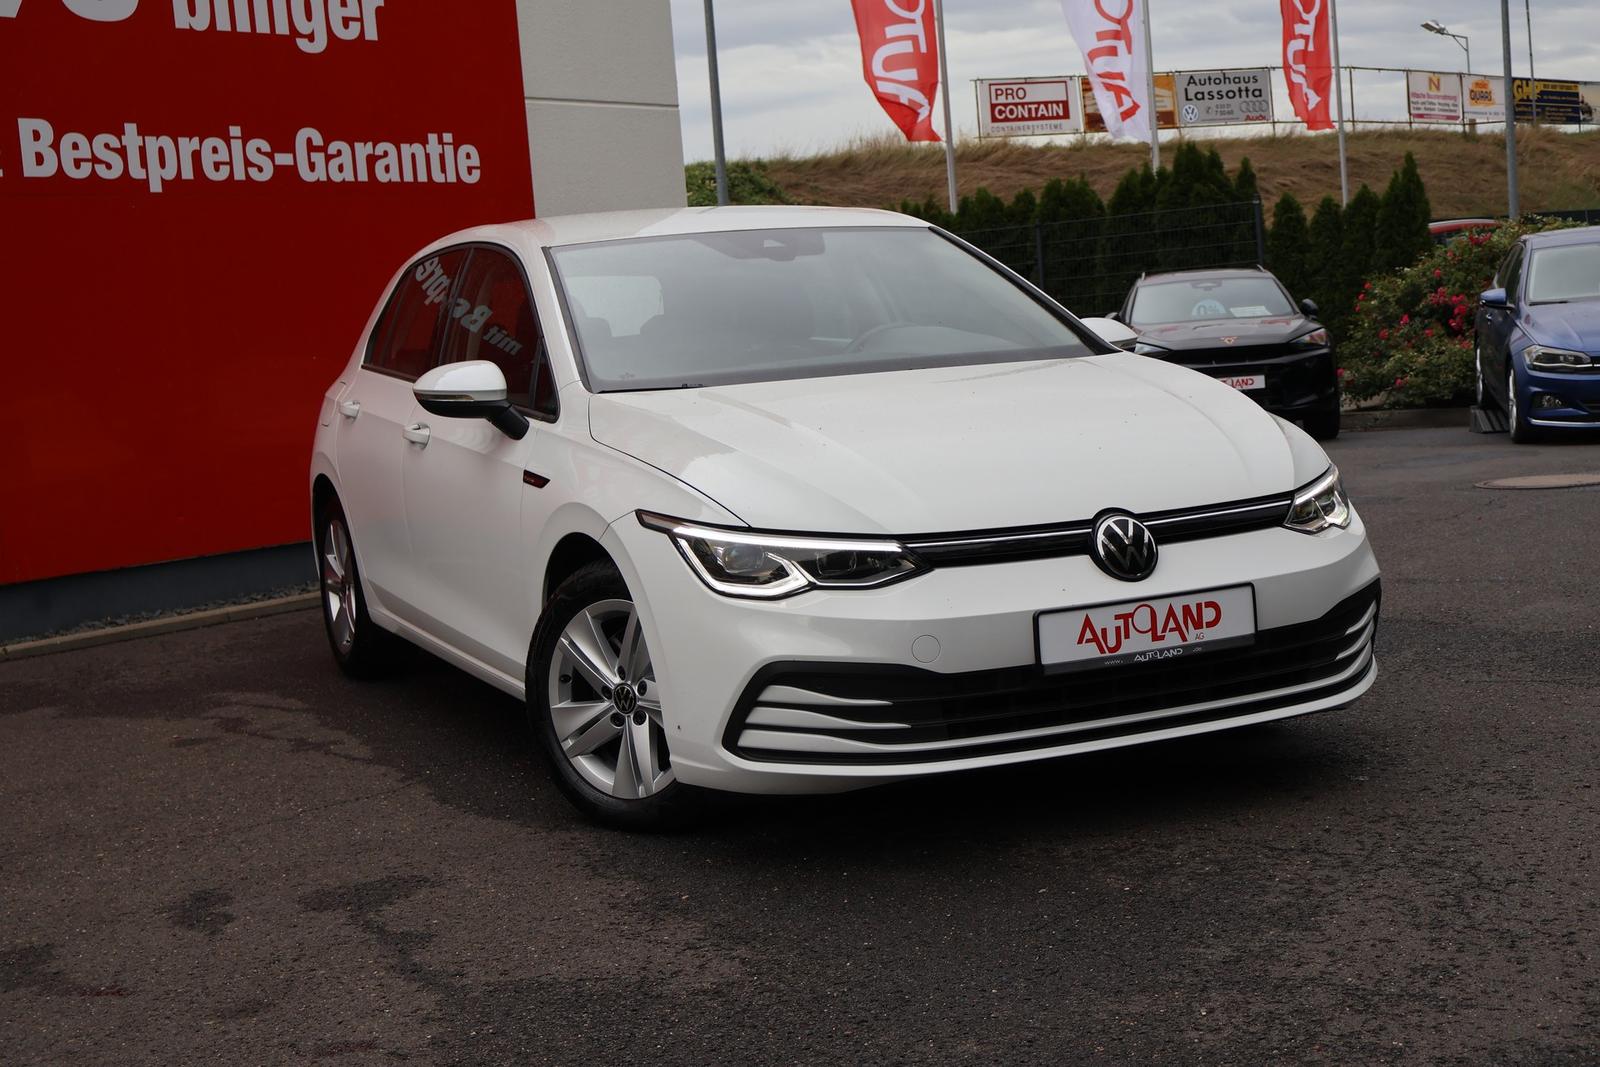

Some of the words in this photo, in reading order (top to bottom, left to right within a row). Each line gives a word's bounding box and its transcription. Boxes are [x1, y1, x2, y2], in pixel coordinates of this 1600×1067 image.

[1187, 73, 1258, 87] Autohaus
[995, 87, 1026, 101] PRO
[1184, 86, 1263, 102] Lassotta
[994, 103, 1064, 119] CONTAIN
[17, 117, 481, 193] Bestpreis-Garantie
[1077, 600, 1222, 655] AUTOLAND
[1134, 648, 1183, 662] AUTOLAND
